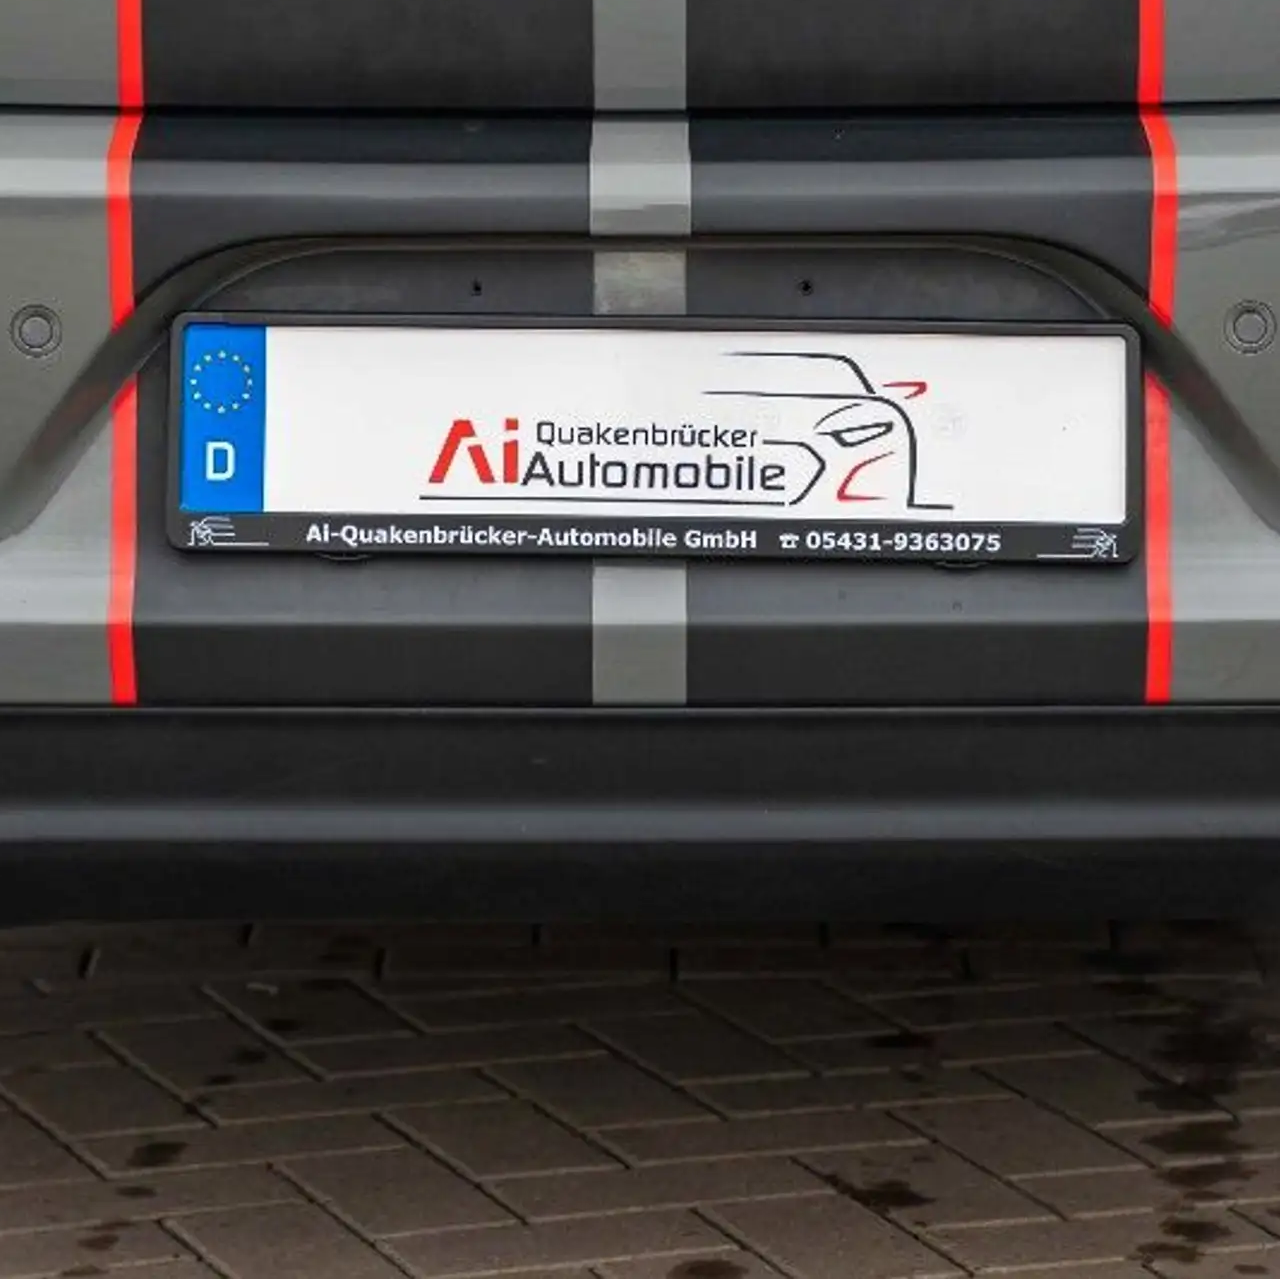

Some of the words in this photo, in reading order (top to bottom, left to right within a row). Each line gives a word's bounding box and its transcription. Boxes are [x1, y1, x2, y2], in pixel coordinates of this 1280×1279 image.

[536, 421, 758, 448] Quakenbrücker
[206, 441, 236, 481] D
[428, 418, 519, 484] Ai
[521, 451, 786, 491] Automobile
[684, 529, 758, 550] GmbH
[805, 531, 1002, 553] 05431-9363075
